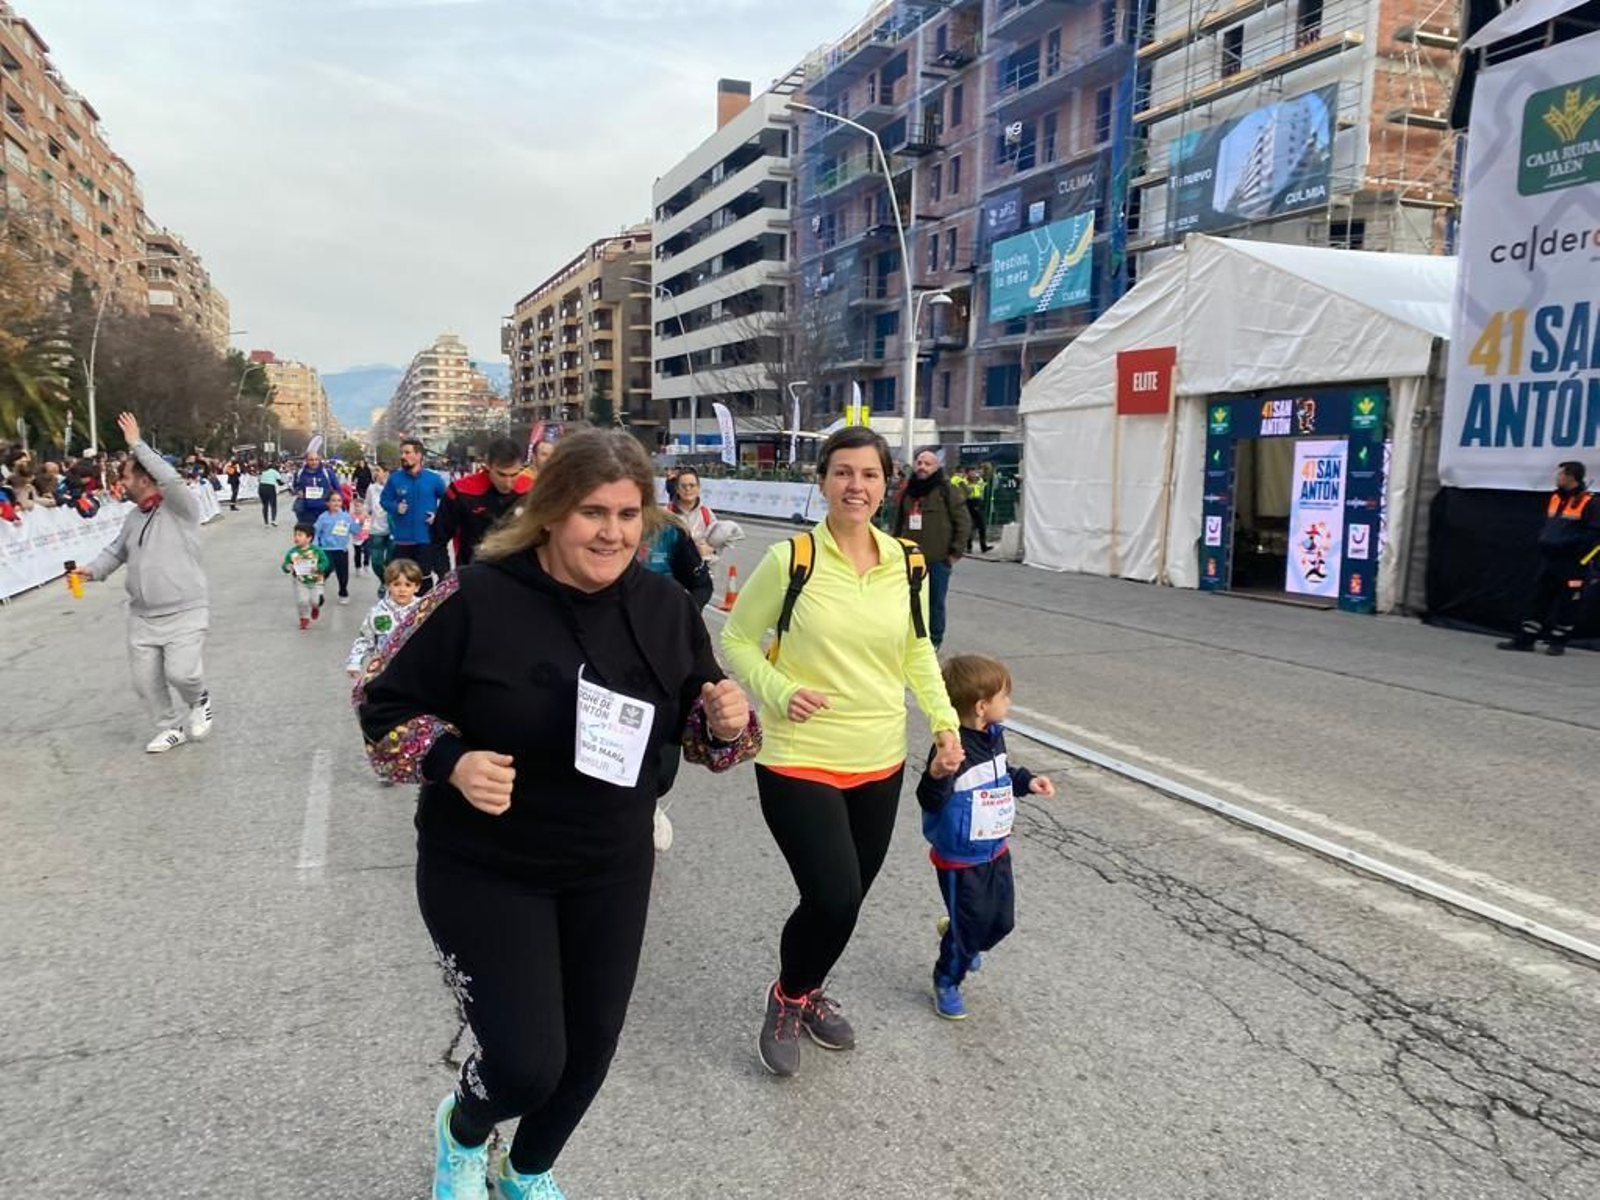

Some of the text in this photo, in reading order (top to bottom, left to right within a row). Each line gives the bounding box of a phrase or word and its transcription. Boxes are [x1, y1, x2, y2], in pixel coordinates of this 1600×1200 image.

[1525, 149, 1559, 168] CAJA
[1183, 167, 1212, 186] nuevo
[1285, 185, 1326, 205] CULMIA
[1468, 301, 1600, 376] 41 SA
[1133, 371, 1159, 392] ELITE
[1273, 399, 1293, 418] SAN
[1302, 459, 1342, 479] 41 SAN
